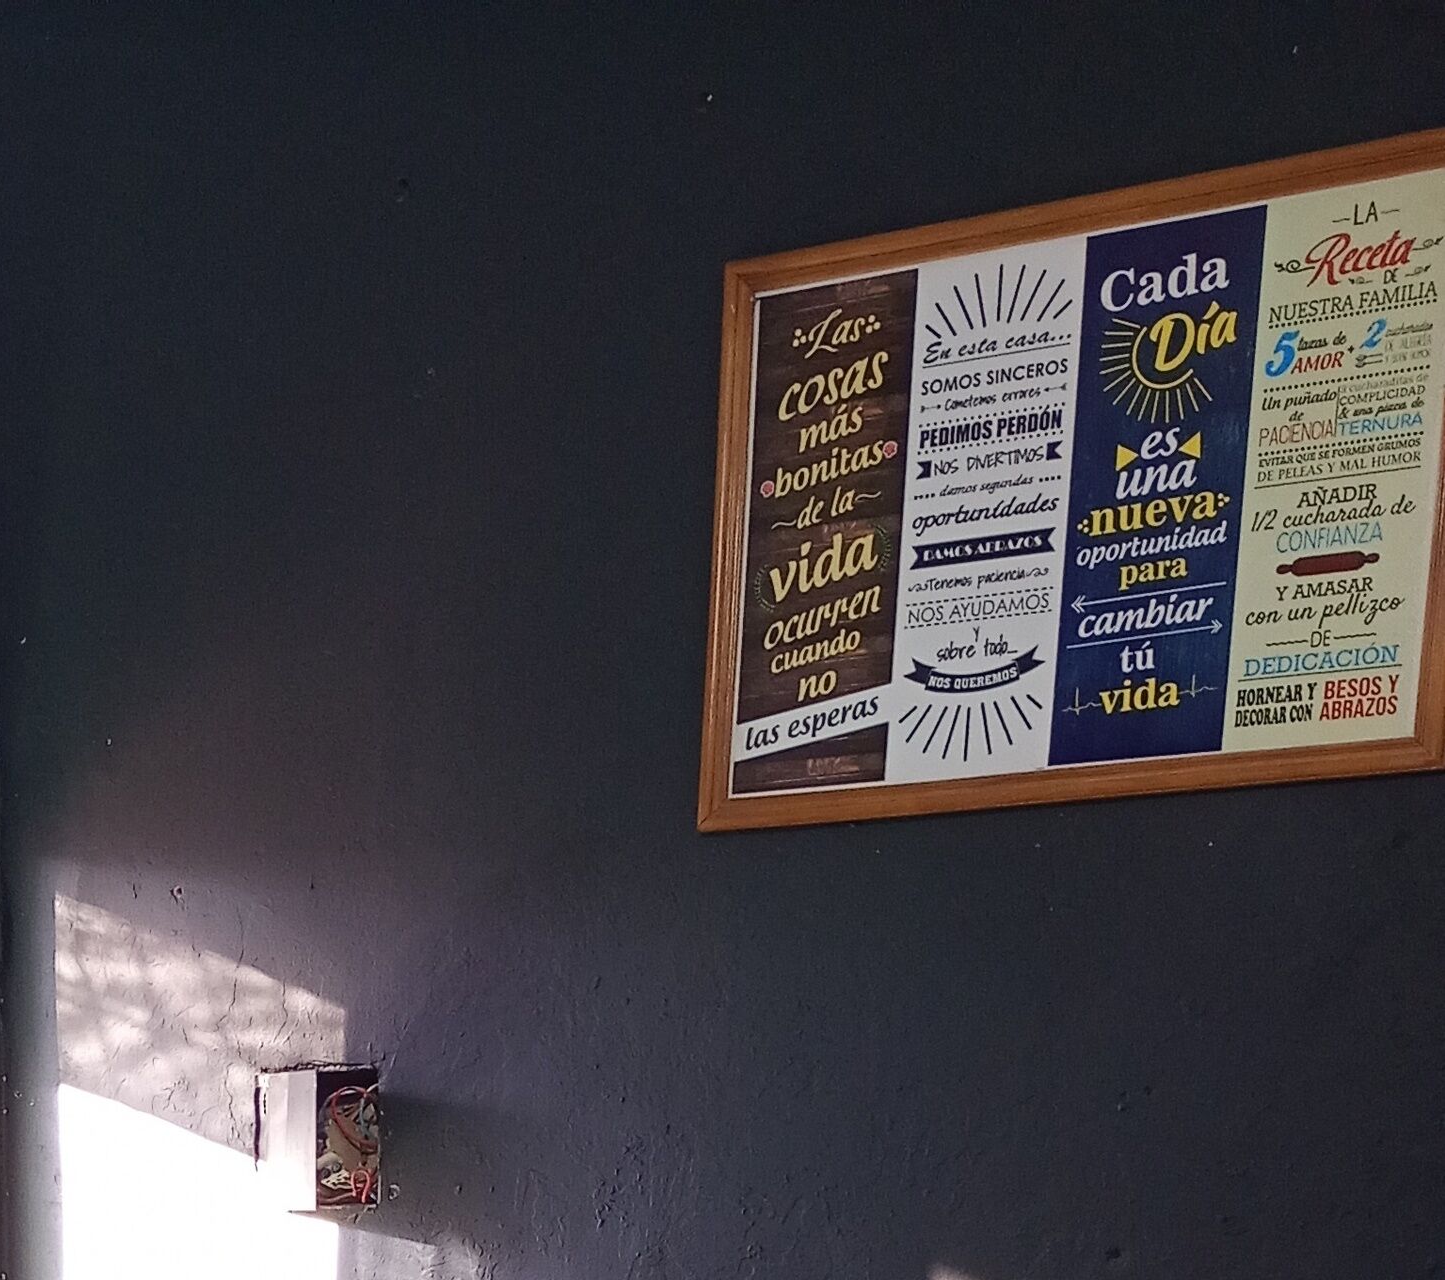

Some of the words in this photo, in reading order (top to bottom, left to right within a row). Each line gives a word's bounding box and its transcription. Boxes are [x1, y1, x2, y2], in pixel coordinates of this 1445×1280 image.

[1354, 200, 1378, 225] LA
[1305, 230, 1416, 287] Receta
[1100, 252, 1230, 312] Cada
[1383, 268, 1398, 284] DE
[1269, 295, 1353, 323] NUESTRA
[1359, 281, 1438, 309] FAMILIA
[805, 308, 865, 358] Las
[1149, 300, 1238, 372] Día
[1360, 317, 1387, 348] 2
[923, 341, 951, 364] En
[958, 338, 997, 356] esta
[1264, 330, 1300, 377] 5
[1333, 331, 1347, 345] de
[1291, 352, 1344, 374] AMOR
[778, 351, 888, 421] cosas
[921, 373, 981, 396] SOMOS
[986, 358, 1068, 385] SINCEROS
[1002, 387, 1041, 402] errores
[1262, 397, 1281, 411] Un
[1284, 389, 1337, 411] puñado
[1339, 385, 1426, 406] COMPLICIDAD
[799, 403, 863, 453] más
[920, 420, 992, 449] PEDIMOS
[996, 405, 1063, 437] PERDÓN
[1289, 411, 1304, 422] de
[1339, 412, 1423, 436] TERNURA
[1140, 427, 1181, 460] es
[1259, 453, 1294, 468] EVITAR
[1296, 451, 1316, 464] QUE
[1318, 449, 1329, 459] SE
[1332, 444, 1375, 458] FORMEN
[1377, 438, 1421, 451] GRUMOS
[775, 440, 884, 498] bonitas
[934, 459, 959, 476] NOS
[967, 446, 1044, 471] DIVERTIMOS
[1258, 469, 1274, 483] DE
[1278, 463, 1323, 480] PELEAS
[1327, 462, 1338, 473] Y
[1340, 457, 1367, 472] MAL
[1372, 451, 1421, 467] HUMOR
[1116, 458, 1197, 499] una
[796, 496, 824, 529] de
[830, 486, 855, 517] la
[1282, 500, 1387, 529] cucharada
[1391, 494, 1416, 514] de
[1297, 483, 1377, 508] AÑADIR
[912, 493, 1060, 537] oportunidades
[1089, 490, 1217, 537] nueva
[923, 542, 973, 562] DAMOS
[976, 535, 1043, 555] ABRAZOS
[1076, 520, 1227, 569] oportunidad
[1276, 522, 1383, 553] CONFIANZA
[769, 532, 878, 603] vida
[1119, 557, 1188, 591] para
[928, 577, 972, 592] Tenemos
[1276, 586, 1289, 601] Y
[1292, 576, 1374, 600] AMASAR
[763, 585, 881, 650] ocurren
[908, 606, 944, 624] NOS
[948, 593, 1050, 620] AYUDAMOS
[1078, 594, 1214, 639] cambiar
[1245, 608, 1282, 626] con
[1288, 604, 1317, 621] un
[1318, 594, 1405, 629] pellizco
[771, 628, 861, 674] cuando
[936, 641, 976, 662] sobre
[1310, 630, 1332, 648] DE
[1120, 641, 1155, 673] tú
[1243, 642, 1399, 677] DEDICACIÓN
[798, 670, 836, 702] no
[928, 675, 952, 689] NOS
[954, 667, 1018, 689] QUEREMOS
[1323, 676, 1383, 700] BESOS
[1388, 674, 1400, 694] Y
[1099, 678, 1180, 715] vida
[1236, 683, 1303, 708] HORNEAR
[1306, 682, 1317, 701] Y
[1319, 695, 1398, 722] ABRAZOS
[746, 725, 779, 750] las
[788, 695, 879, 737] esperas
[1234, 705, 1287, 728] DECORAR
[1289, 703, 1314, 723] CON
